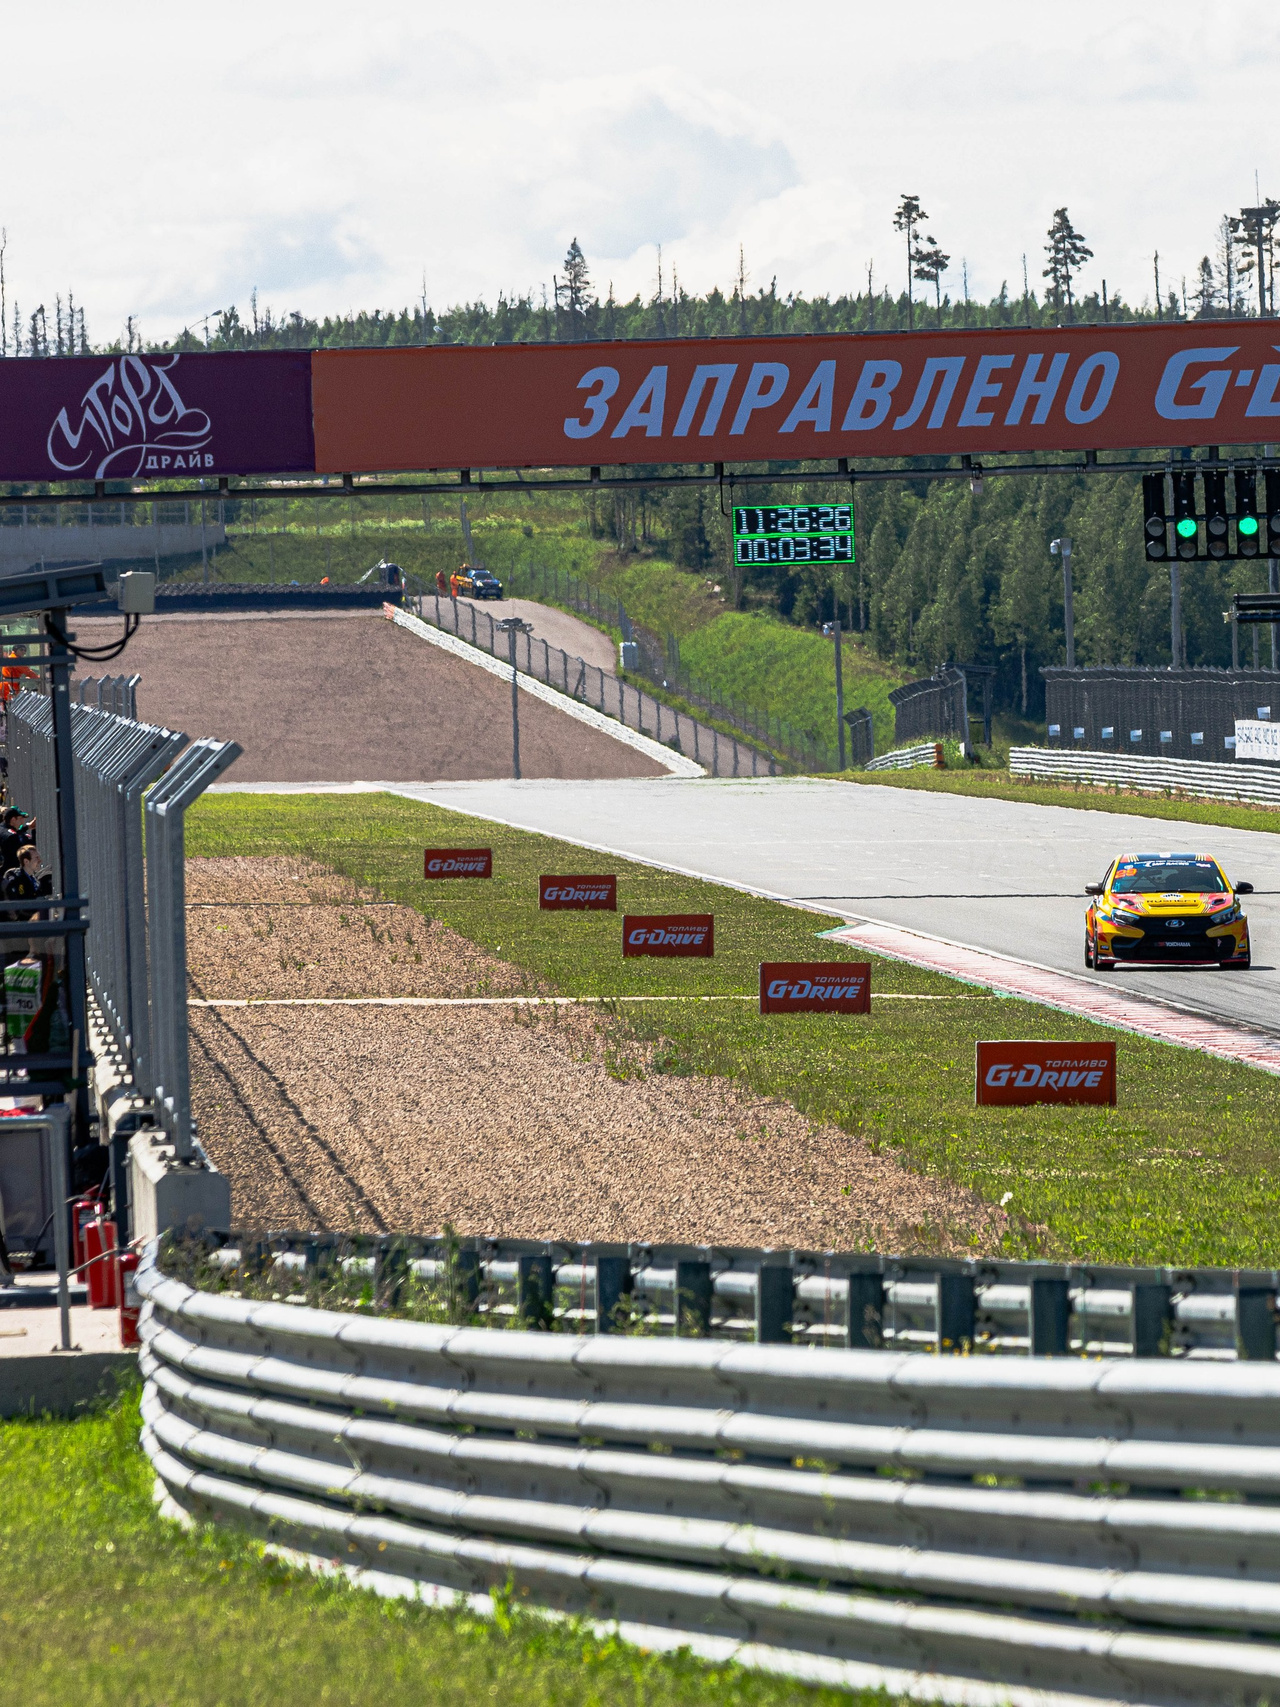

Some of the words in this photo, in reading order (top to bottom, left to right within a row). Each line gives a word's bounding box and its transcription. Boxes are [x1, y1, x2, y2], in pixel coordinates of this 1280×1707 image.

[563, 350, 1121, 439] ЗАПРАВЛЕНО
[145, 451, 215, 469] ДРАЙВ
[737, 536, 851, 562] 00:03:34
[1045, 1060, 1108, 1068] ТОПЛИВО
